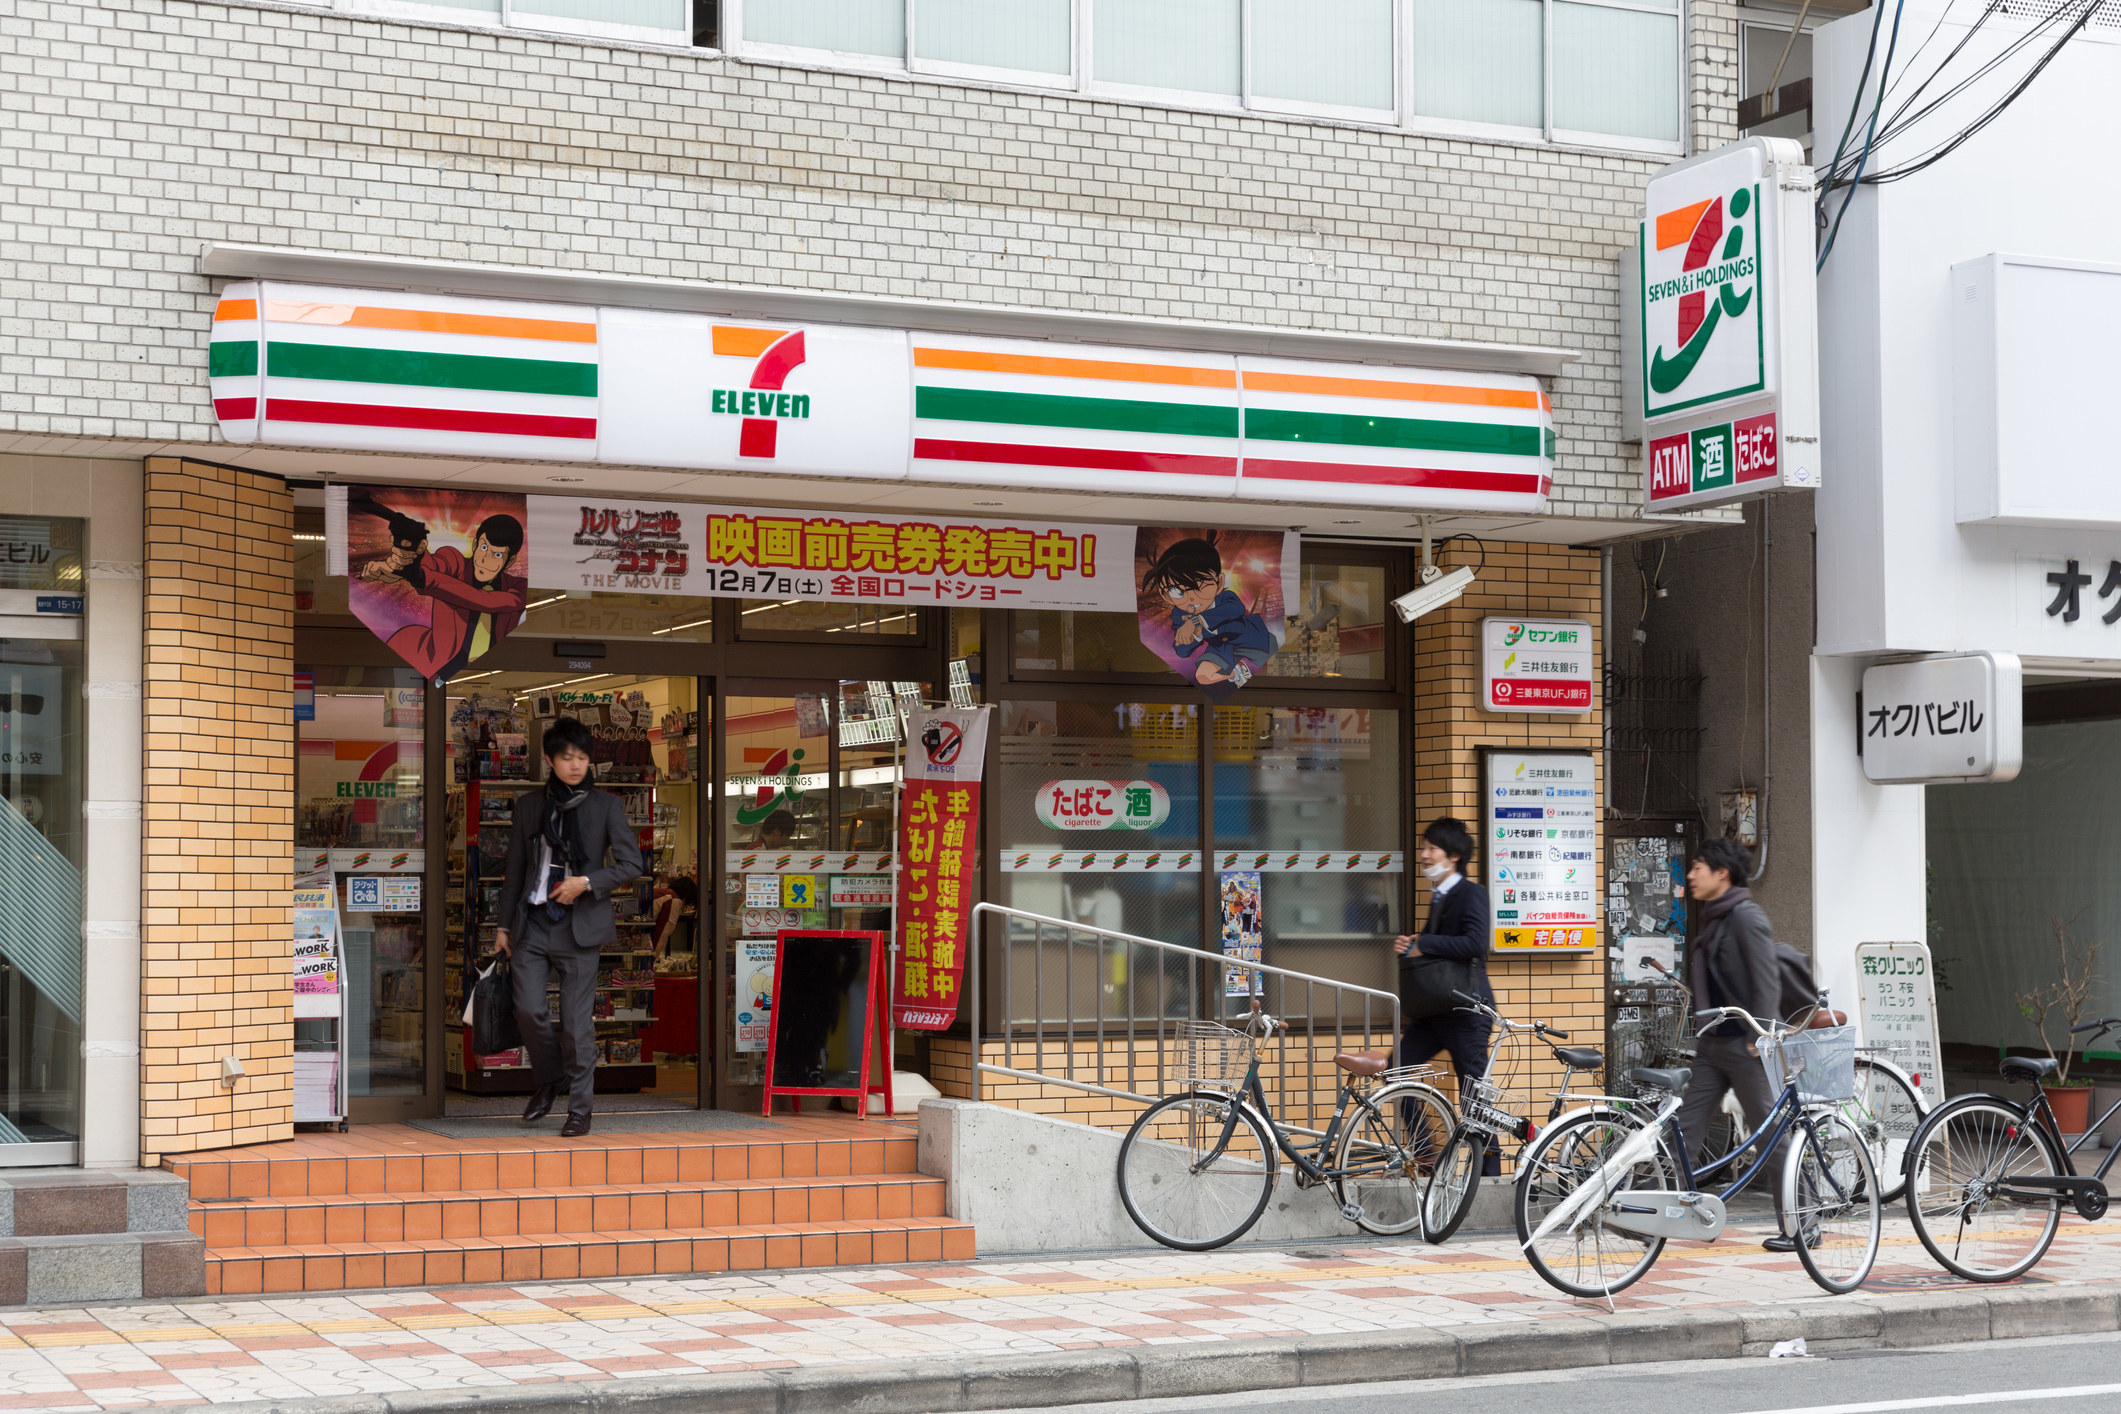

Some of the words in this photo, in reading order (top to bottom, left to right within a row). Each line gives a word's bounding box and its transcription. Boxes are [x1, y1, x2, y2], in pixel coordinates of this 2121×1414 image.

[1696, 257, 1754, 289] HOLDINGS
[1736, 424, 1776, 473] たばこ
[1700, 434, 1725, 483] 酒
[1652, 443, 1688, 490] ATM
[707, 515, 1096, 579] 映画前売券発売中!
[581, 574, 616, 588] THE
[625, 575, 682, 591] MOVIE
[706, 568, 823, 596] 12月7日(土)
[830, 574, 1022, 601] 全国ロードショー
[57, 600, 82, 609] 15-17
[1528, 629, 1578, 643] セブン銀行
[1521, 661, 1579, 673] 三井住友銀行
[1516, 687, 1588, 699] 三菱東京UFJ銀行
[1868, 700, 1984, 739] オクバビル
[1529, 769, 1573, 778] 三井住友銀行
[768, 776, 812, 786] HOLDINGS
[1052, 787, 1113, 817] たばこ
[1126, 788, 1152, 817] 酒
[1064, 818, 1101, 827] cigarette
[1128, 818, 1152, 827] liquor
[1507, 829, 1542, 838] りそな銀行
[1561, 830, 1594, 839] 京都銀行
[1510, 851, 1542, 859] 南都銀行
[1516, 872, 1543, 880] 新生銀行
[1521, 891, 1589, 901] 各種公共料金窓口
[1534, 930, 1583, 945] 宅急便
[295, 943, 330, 956] WORK
[301, 962, 336, 975] WORK
[1862, 955, 1925, 976] 森クリニック
[1878, 983, 1893, 993] うつ
[1899, 982, 1914, 993] 不安
[1879, 995, 1915, 1007] パニック
